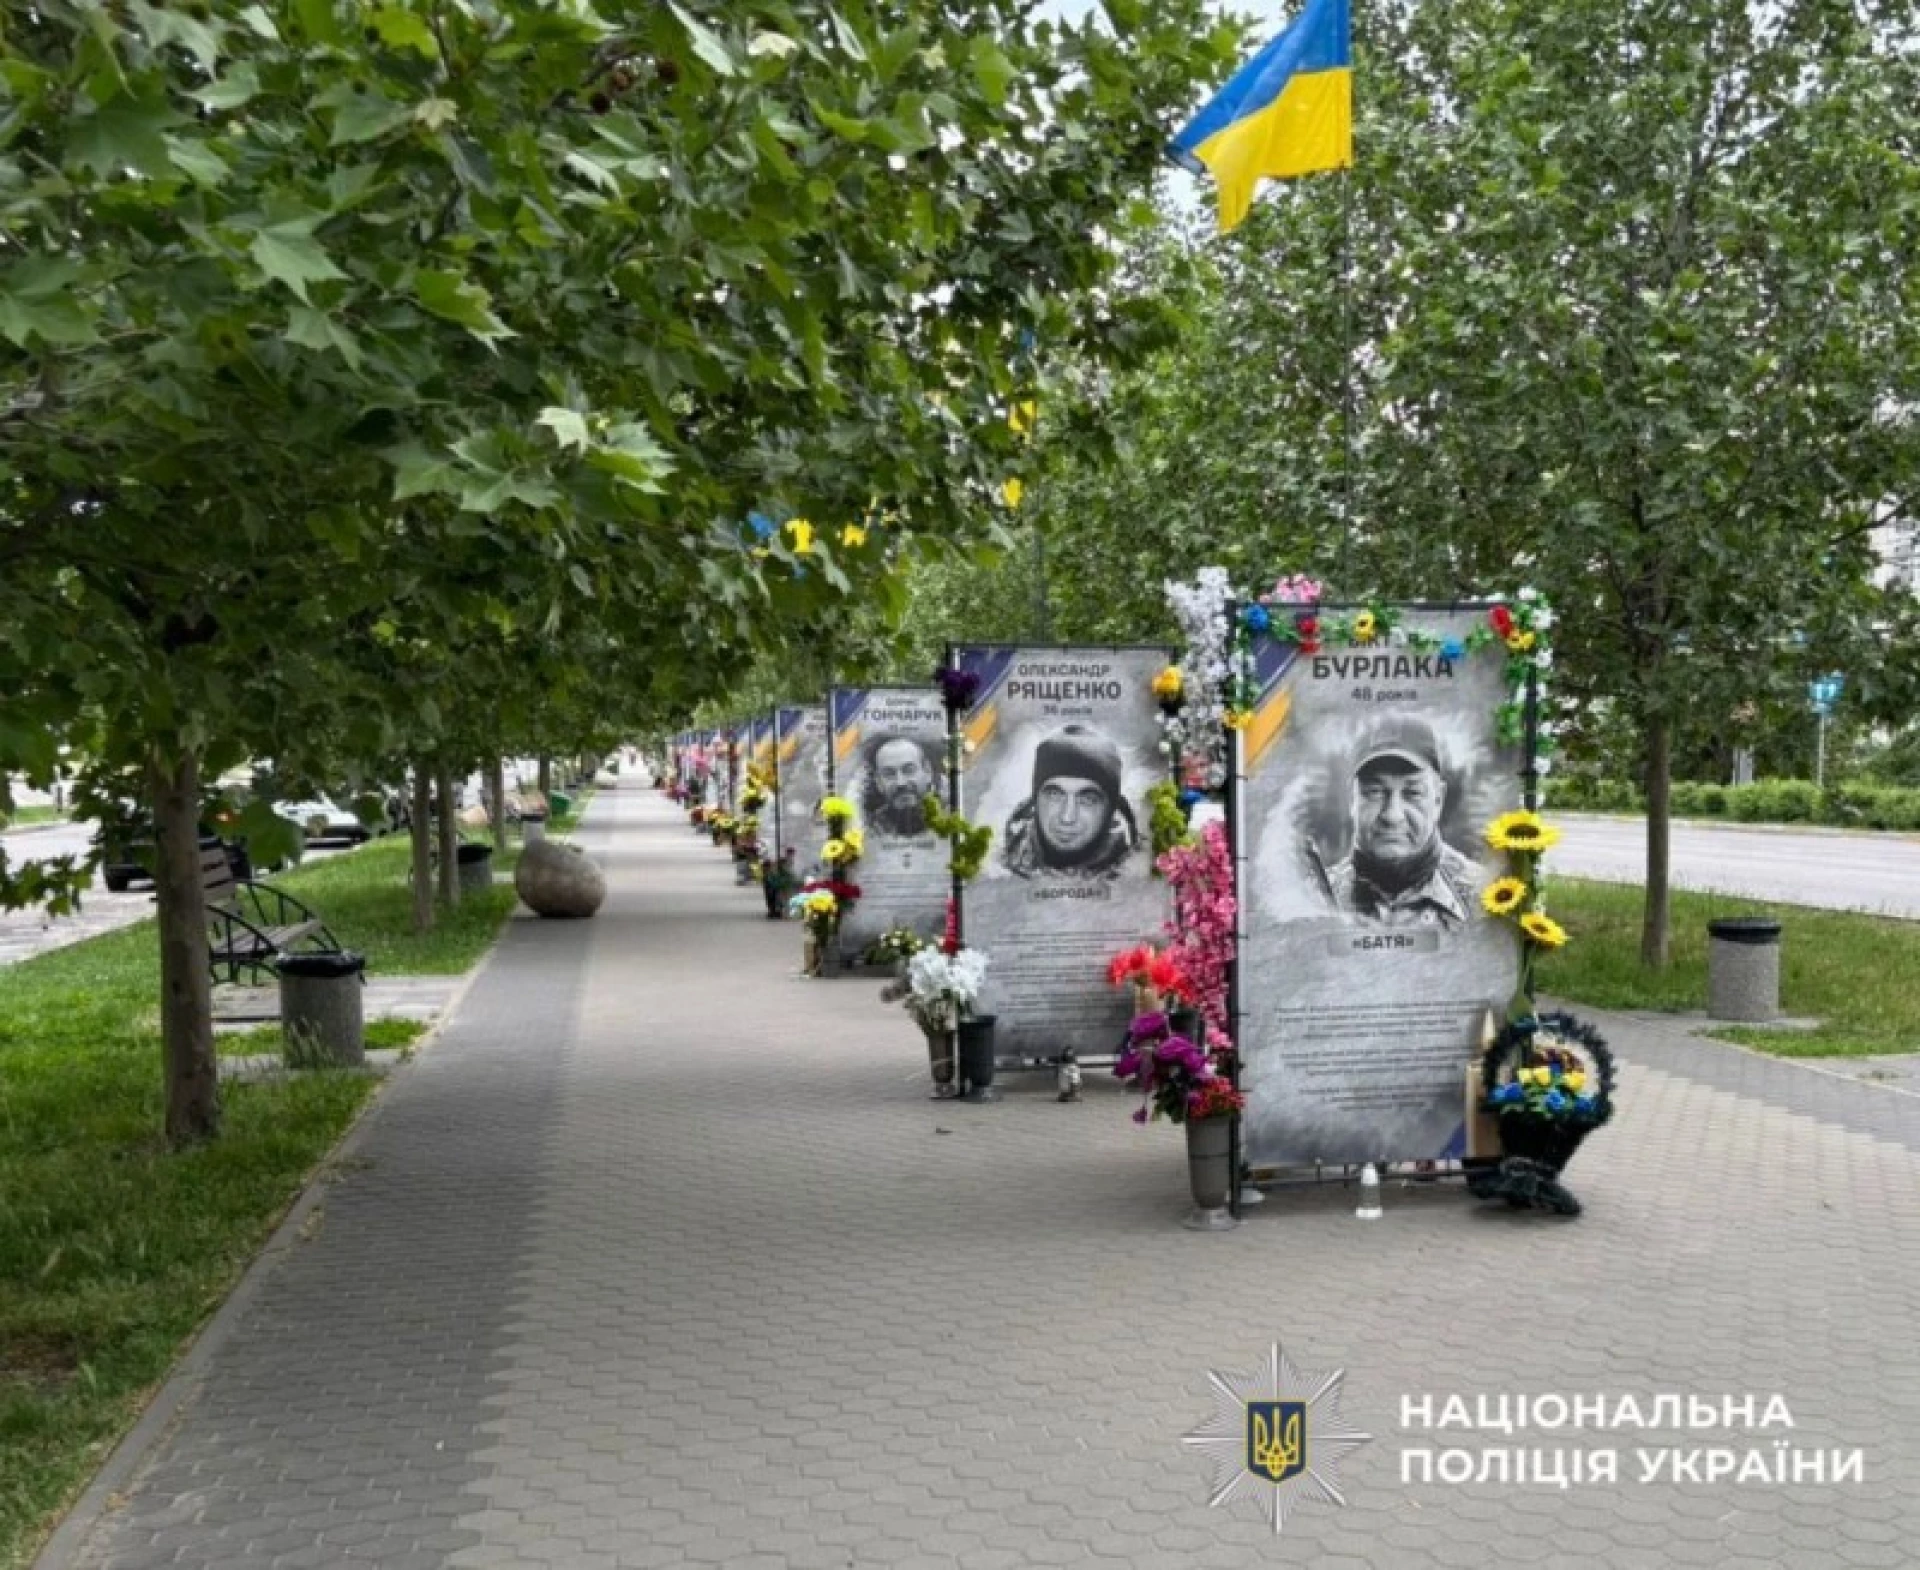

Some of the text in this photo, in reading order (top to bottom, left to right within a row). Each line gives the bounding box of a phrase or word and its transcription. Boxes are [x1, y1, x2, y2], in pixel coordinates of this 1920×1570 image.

[1017, 664, 1111, 678] ОЛЕКСАНДР
[1312, 655, 1454, 679] БУРЛАКА
[1007, 681, 1122, 702] РЯЩЕНКО
[863, 709, 943, 721] ГОНЧАРУК
[1351, 933, 1415, 950] «БАТЯ»
